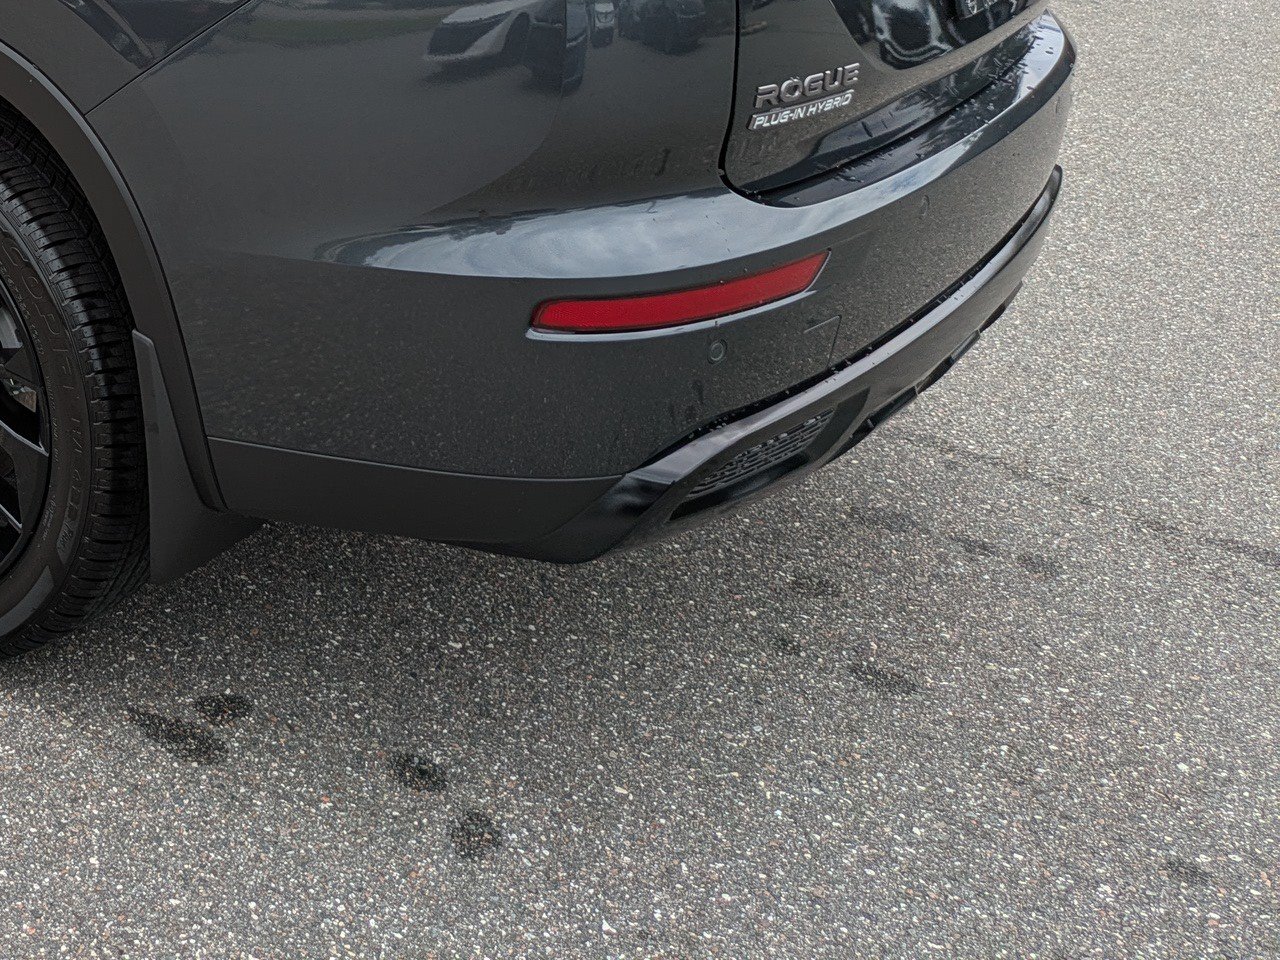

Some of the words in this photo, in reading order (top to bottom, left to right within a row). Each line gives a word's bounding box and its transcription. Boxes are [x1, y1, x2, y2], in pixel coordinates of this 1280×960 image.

[754, 62, 861, 109] ROGUE
[752, 105, 807, 130] PLUG-IN
[807, 92, 853, 117] HYBRID
